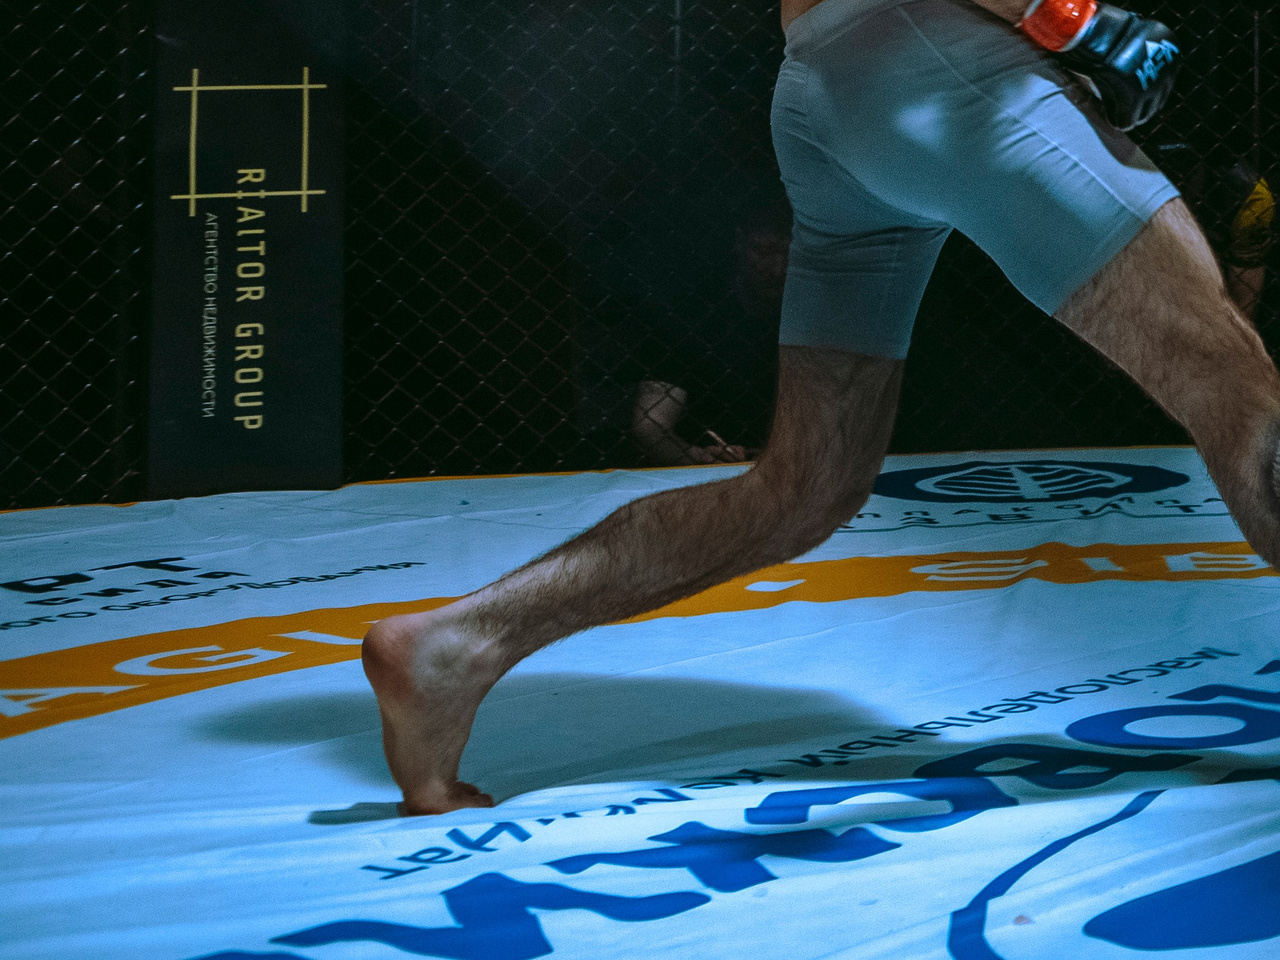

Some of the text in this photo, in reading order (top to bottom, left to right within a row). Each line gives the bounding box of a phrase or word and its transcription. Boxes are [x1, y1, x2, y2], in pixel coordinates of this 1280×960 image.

[201, 212, 219, 418] АГЕНТСТВО НЕДВИЖИМОСТИ
[233, 321, 266, 431] GROUP
